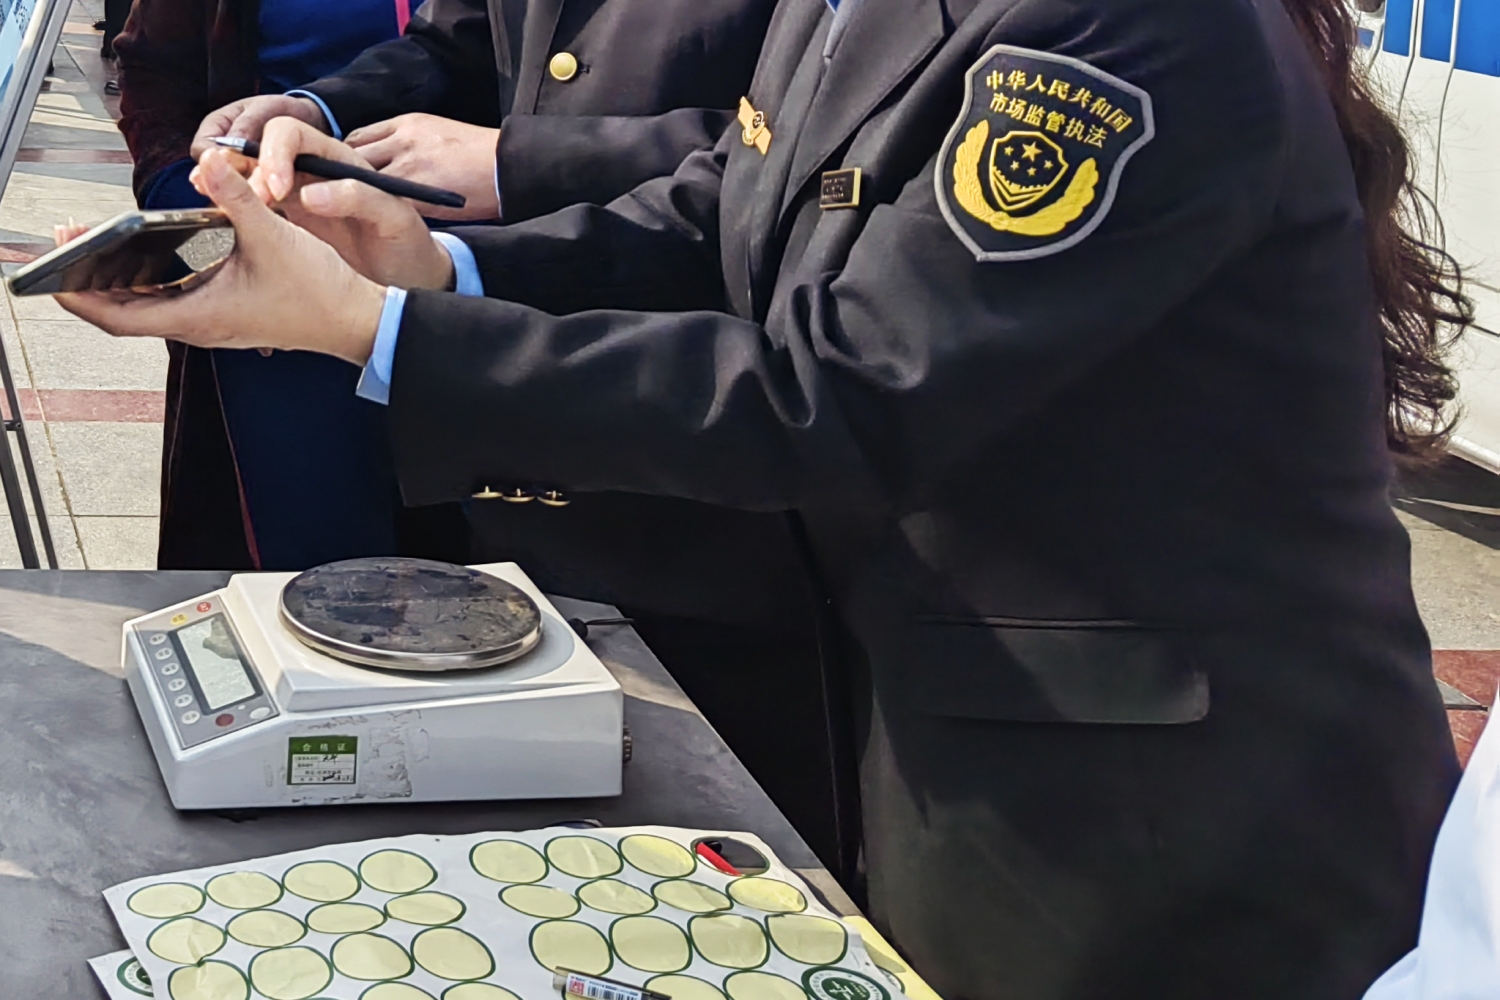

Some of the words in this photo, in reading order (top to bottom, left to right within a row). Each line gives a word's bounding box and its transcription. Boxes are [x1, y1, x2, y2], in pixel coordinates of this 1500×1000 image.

[986, 69, 1133, 133] 中华人民共和国
[989, 92, 1108, 149] 市场监管执法
